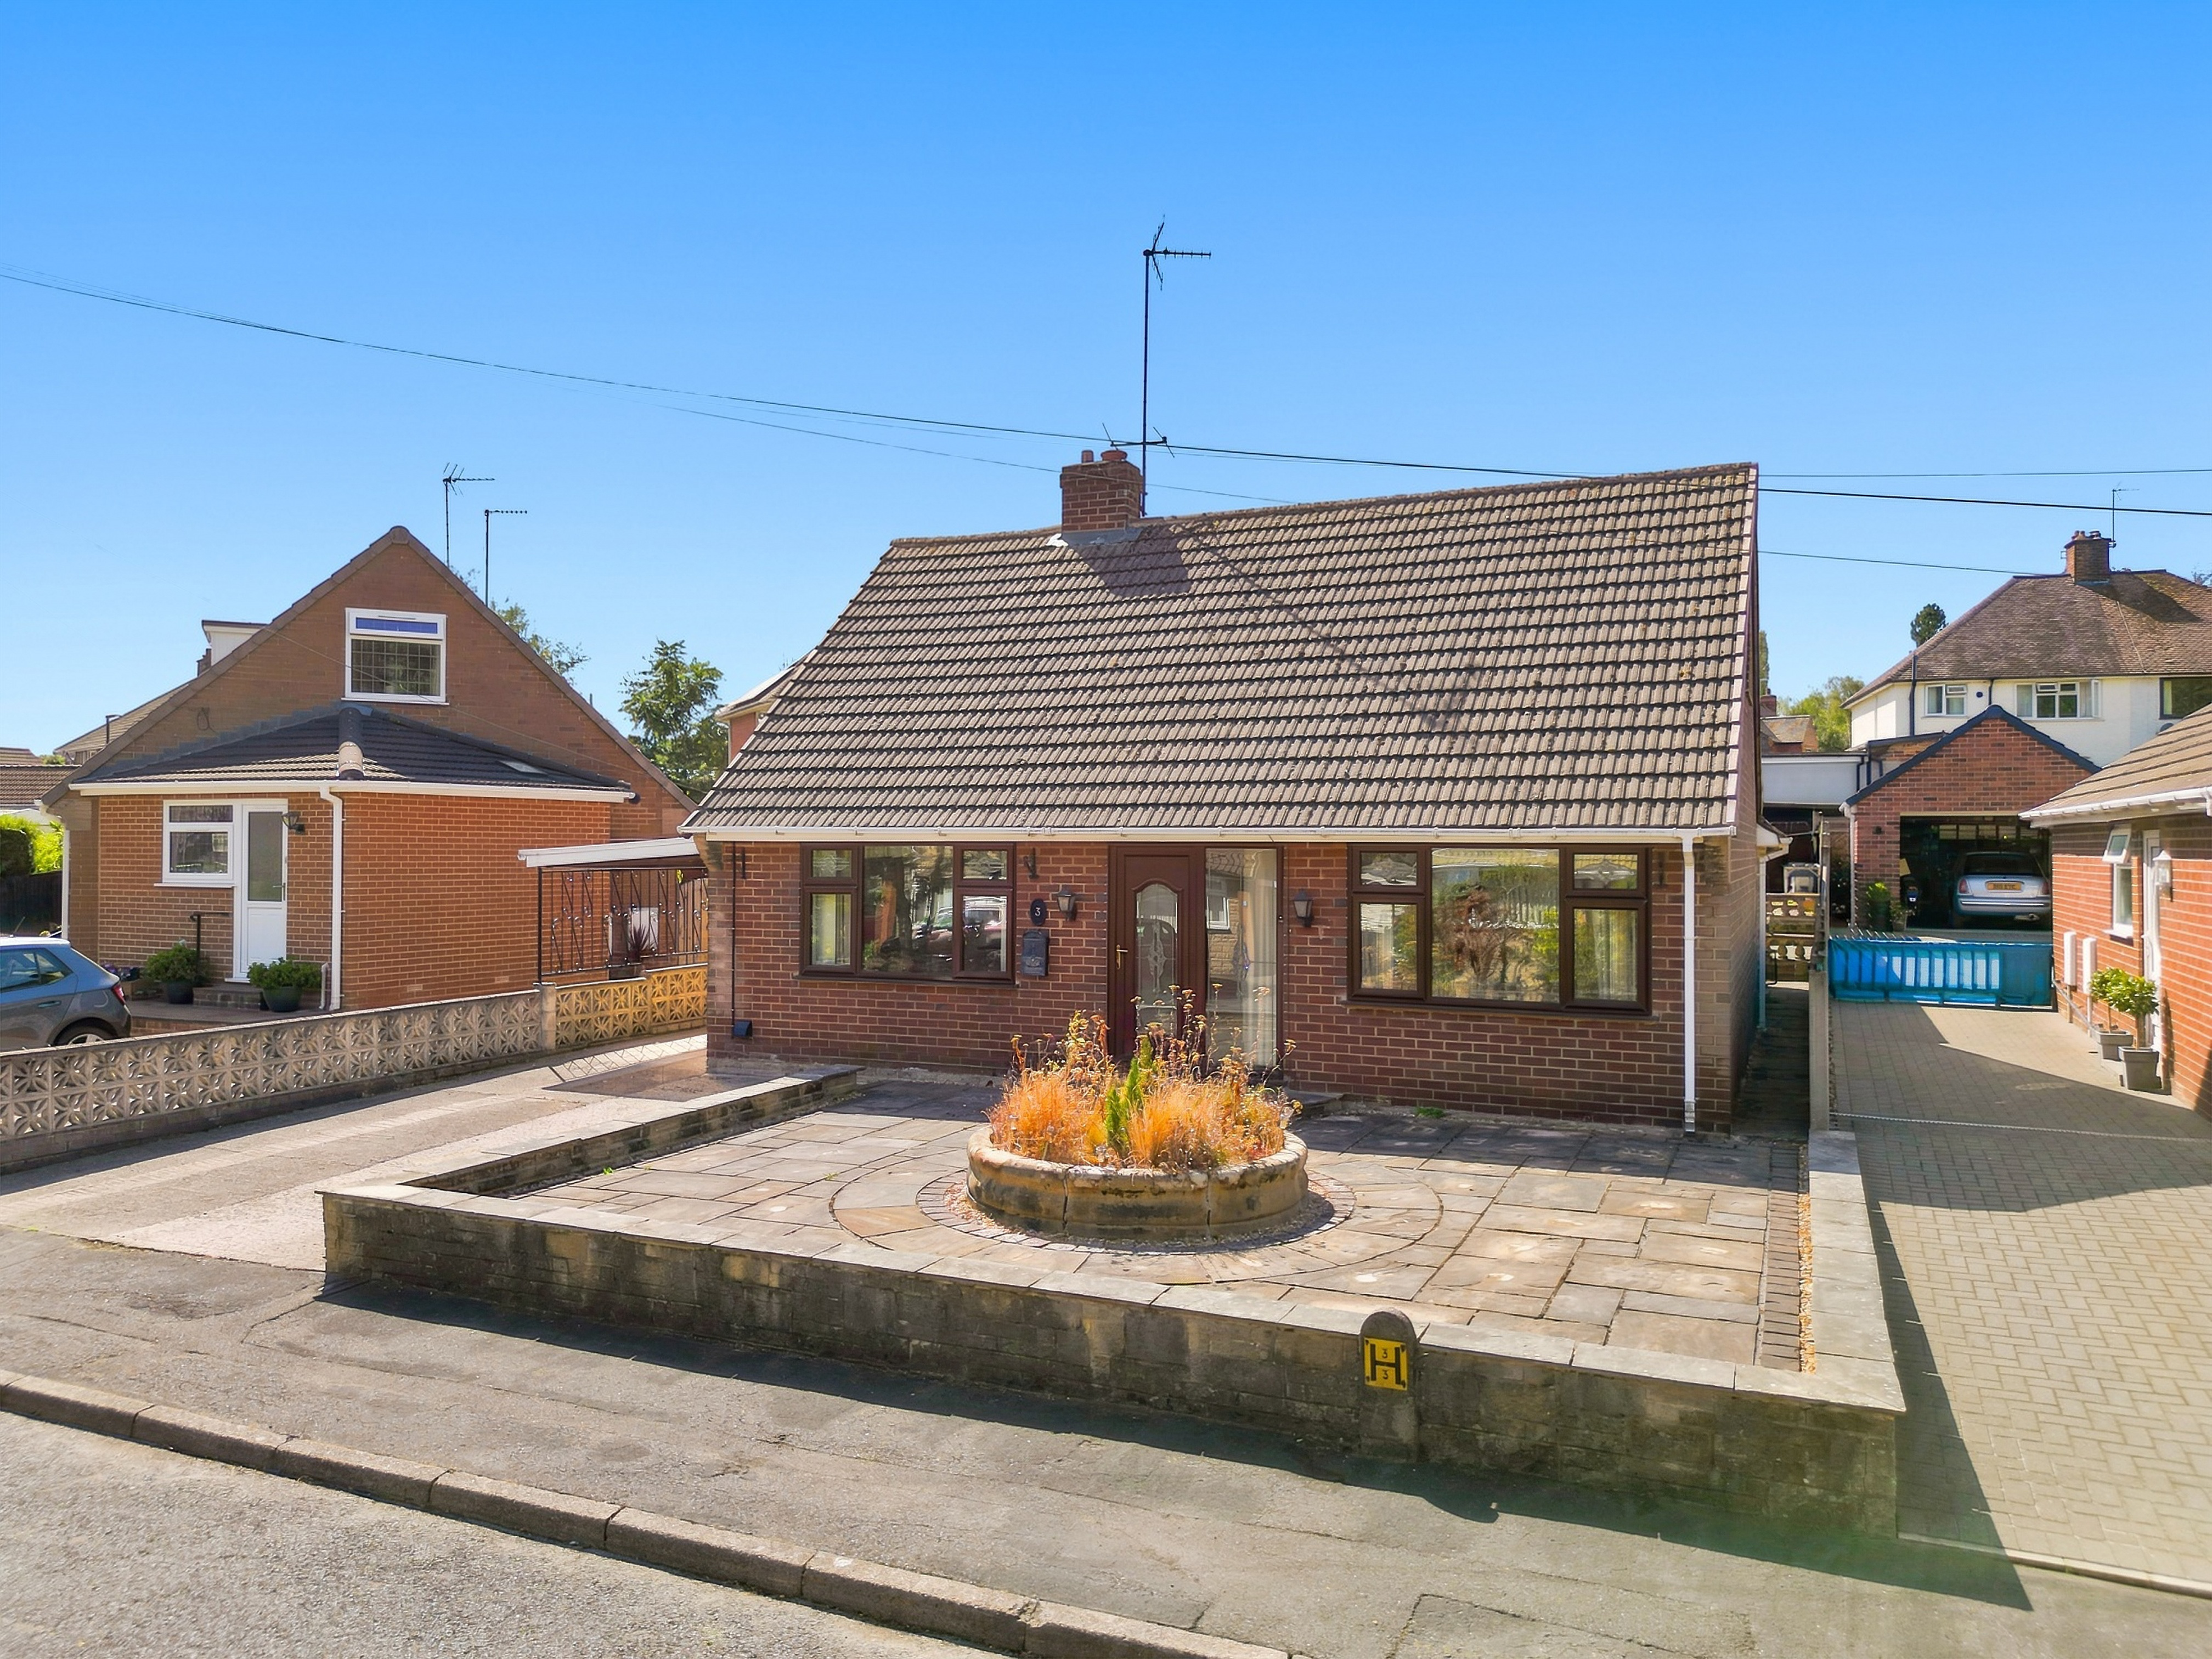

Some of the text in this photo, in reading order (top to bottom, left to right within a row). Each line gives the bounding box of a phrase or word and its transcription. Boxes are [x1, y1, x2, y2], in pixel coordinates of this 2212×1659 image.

[1035, 907, 1041, 916] 3
[1382, 1348, 1388, 1359] 3
[1370, 1343, 1401, 1385] H
[1383, 1369, 1389, 1380] 3
